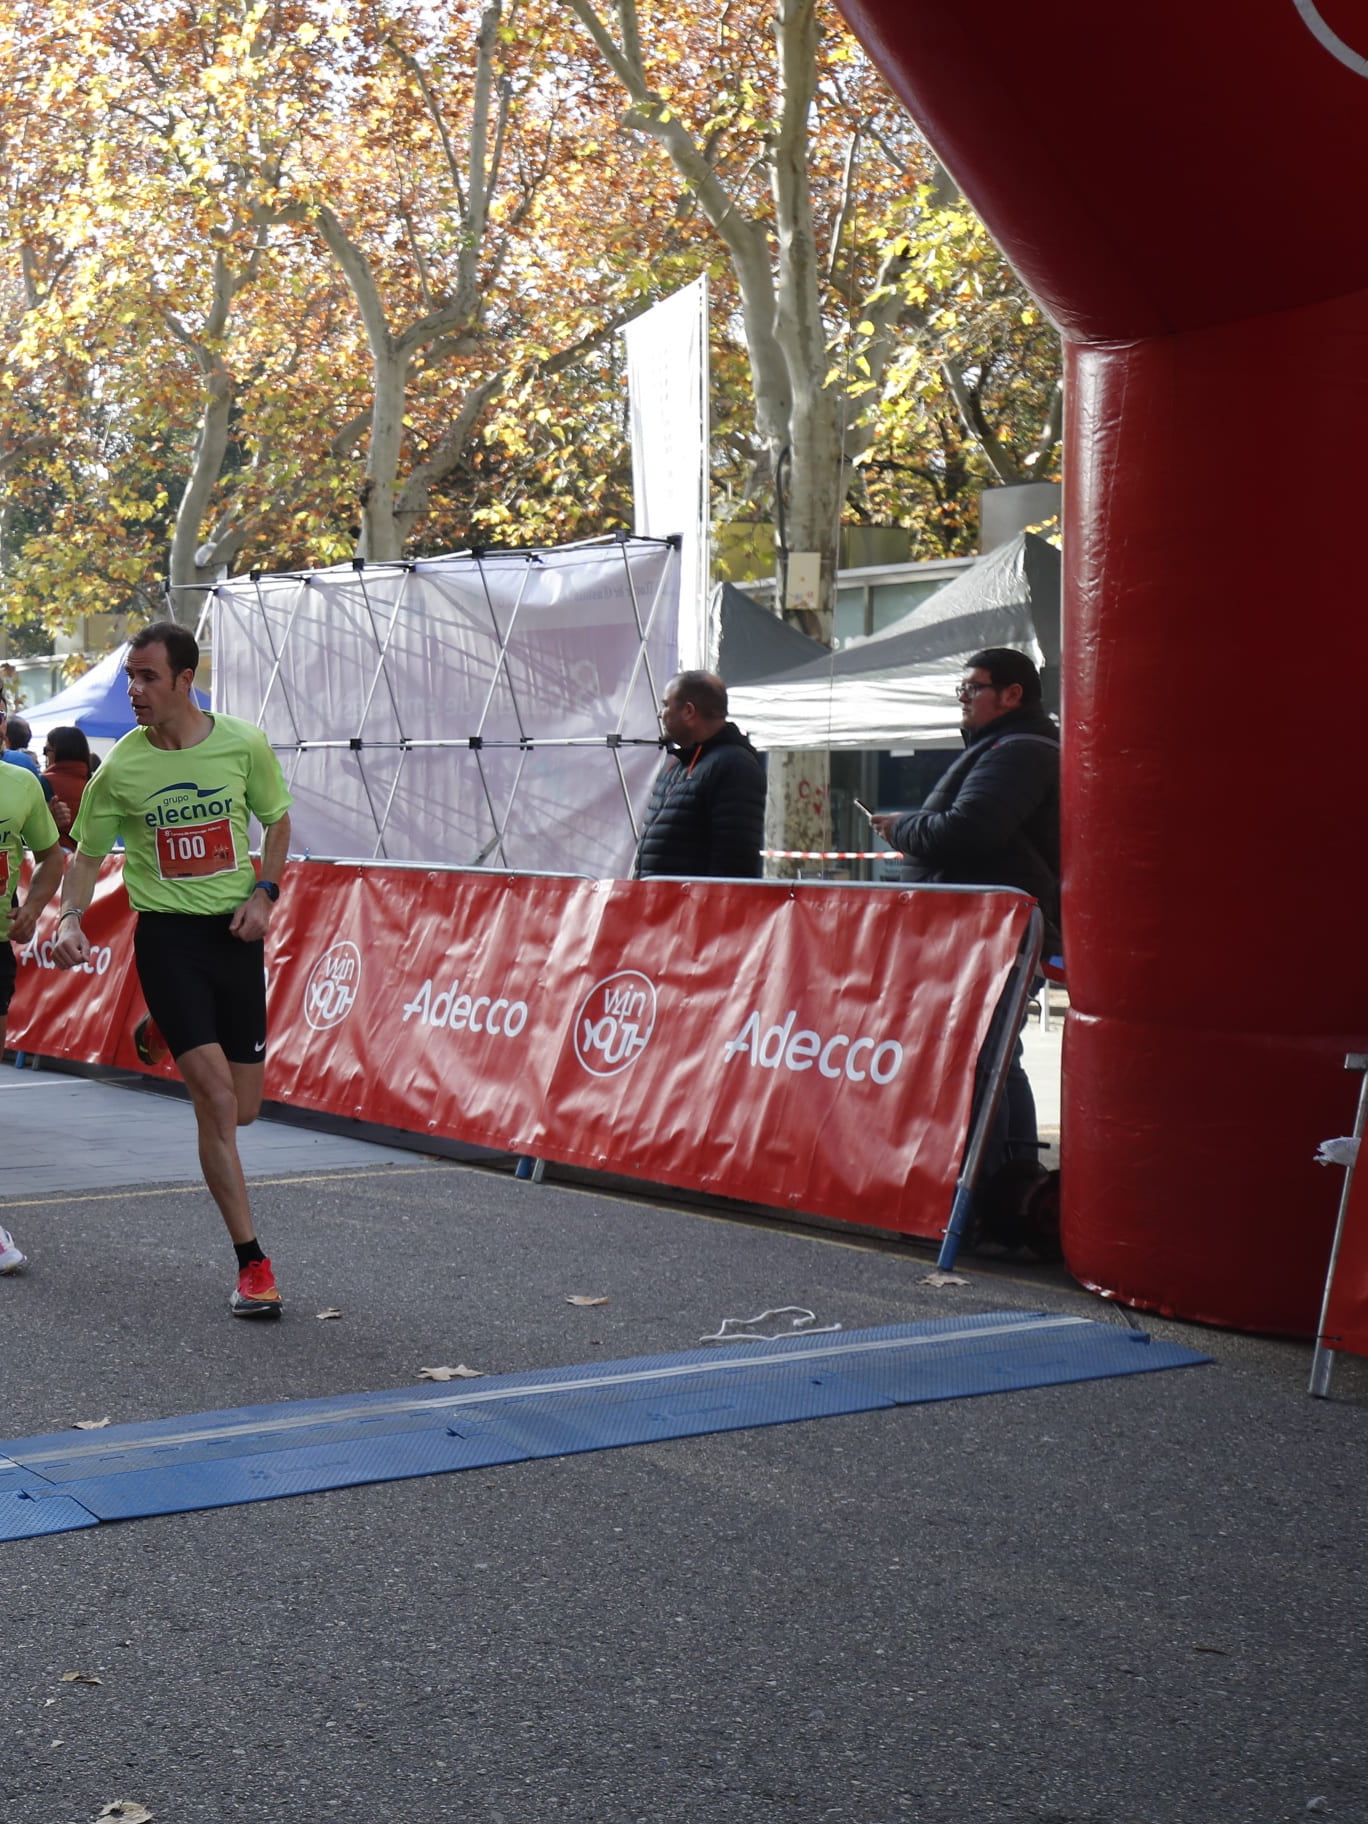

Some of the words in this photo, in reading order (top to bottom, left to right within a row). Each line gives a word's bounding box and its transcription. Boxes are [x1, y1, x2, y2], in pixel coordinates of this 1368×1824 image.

[145, 798, 233, 827] elecnor
[163, 795, 189, 806] grupo
[166, 835, 206, 860] 100
[402, 979, 528, 1037] Adecco
[724, 1010, 904, 1084] Adecco
